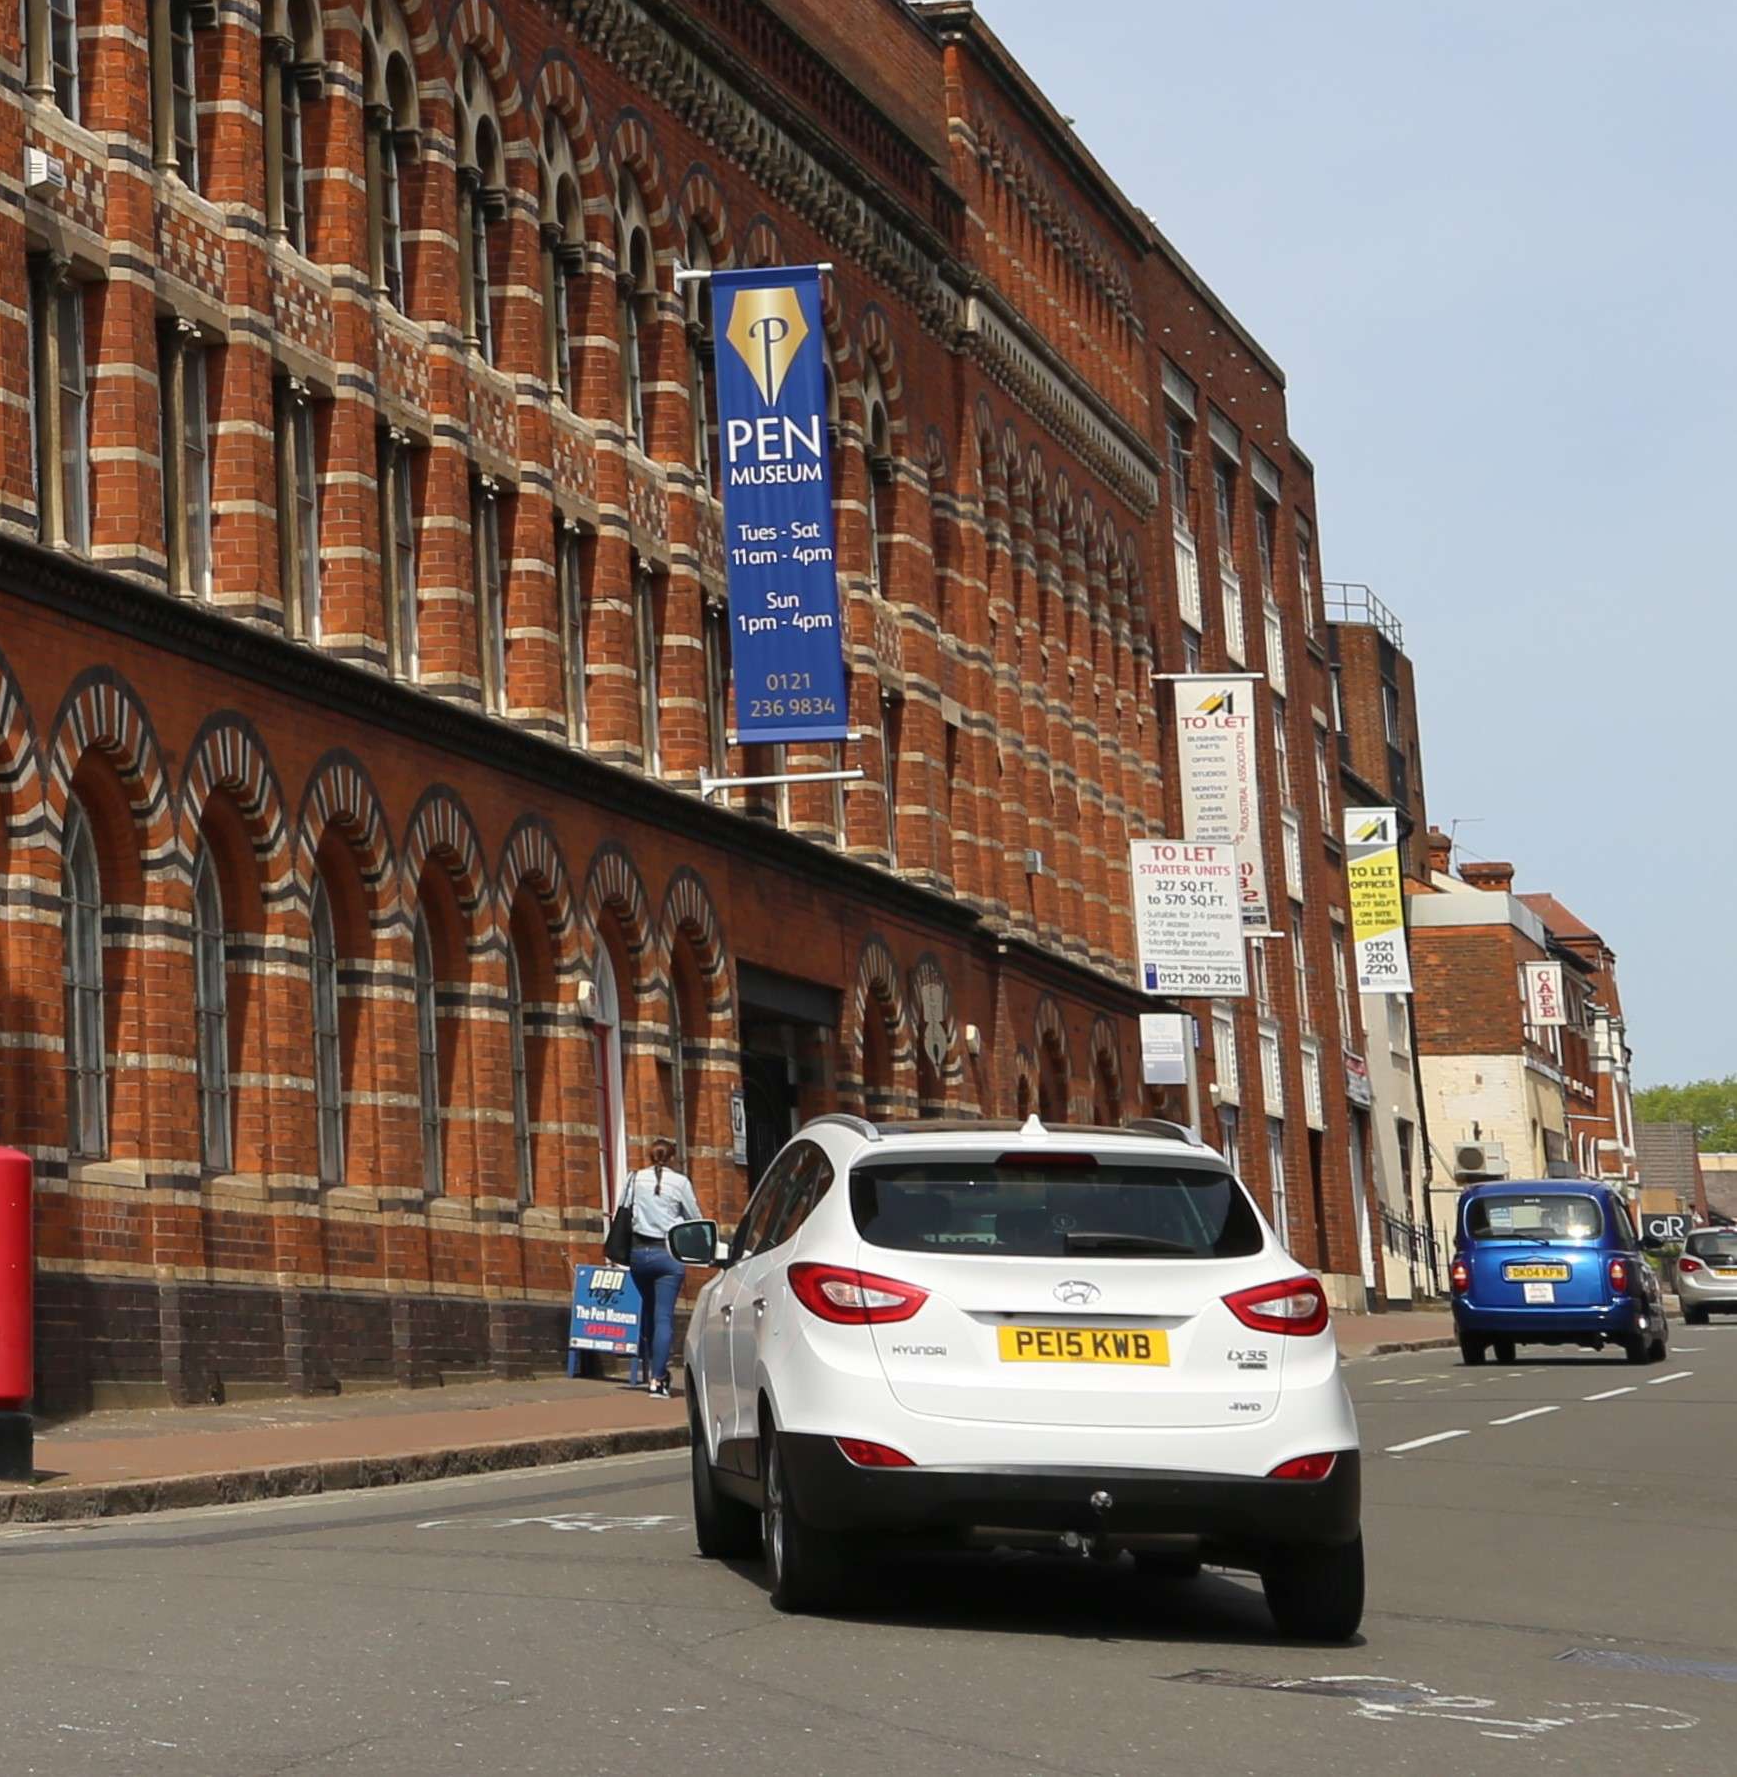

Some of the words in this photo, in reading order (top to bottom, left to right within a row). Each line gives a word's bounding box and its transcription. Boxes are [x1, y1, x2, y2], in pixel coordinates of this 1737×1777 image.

[727, 415, 822, 463] PEN
[730, 463, 823, 486] MUSEUM
[738, 524, 777, 541] Tues
[790, 522, 820, 539] Sat
[732, 547, 777, 565] 11am
[792, 546, 832, 566] 4pm
[766, 592, 799, 609] Sun
[738, 615, 777, 635] 1pm
[792, 613, 832, 633] 4pm
[766, 673, 811, 691] 0121
[750, 699, 785, 717] 236
[789, 697, 835, 717] 9834
[1180, 717, 1207, 730] TO
[1215, 716, 1249, 729] LET
[1236, 732, 1247, 783] ASSOCIATION
[1239, 786, 1250, 833] INDUSTRIAL
[1151, 846, 1176, 861] TO
[1184, 846, 1216, 862] LET
[1139, 864, 1191, 875] STARTER
[1195, 866, 1231, 876] UNITS
[1350, 867, 1367, 877] TO
[1371, 866, 1393, 876] LET
[1156, 881, 1175, 891] 327
[1181, 881, 1218, 893] SQ.FT.
[1350, 880, 1395, 889] OFFICES
[1148, 895, 1161, 905] to
[1165, 895, 1186, 905] 570
[1191, 895, 1227, 907] SQ.FT.
[1191, 931, 1220, 940] parking
[1365, 942, 1394, 952] 0121
[1367, 953, 1394, 963] 200
[1365, 964, 1398, 974] 2210
[1159, 974, 1184, 983] 0121
[1188, 974, 1210, 984] 200
[1215, 974, 1242, 984] 2210
[1537, 971, 1555, 1018] CAFE
[576, 1305, 589, 1319] The
[591, 1306, 605, 1321] Pen
[606, 1309, 637, 1325] Museum
[892, 1345, 947, 1356] HYUNDAI
[1016, 1330, 1084, 1358] PE15
[1093, 1333, 1151, 1360] KWB
